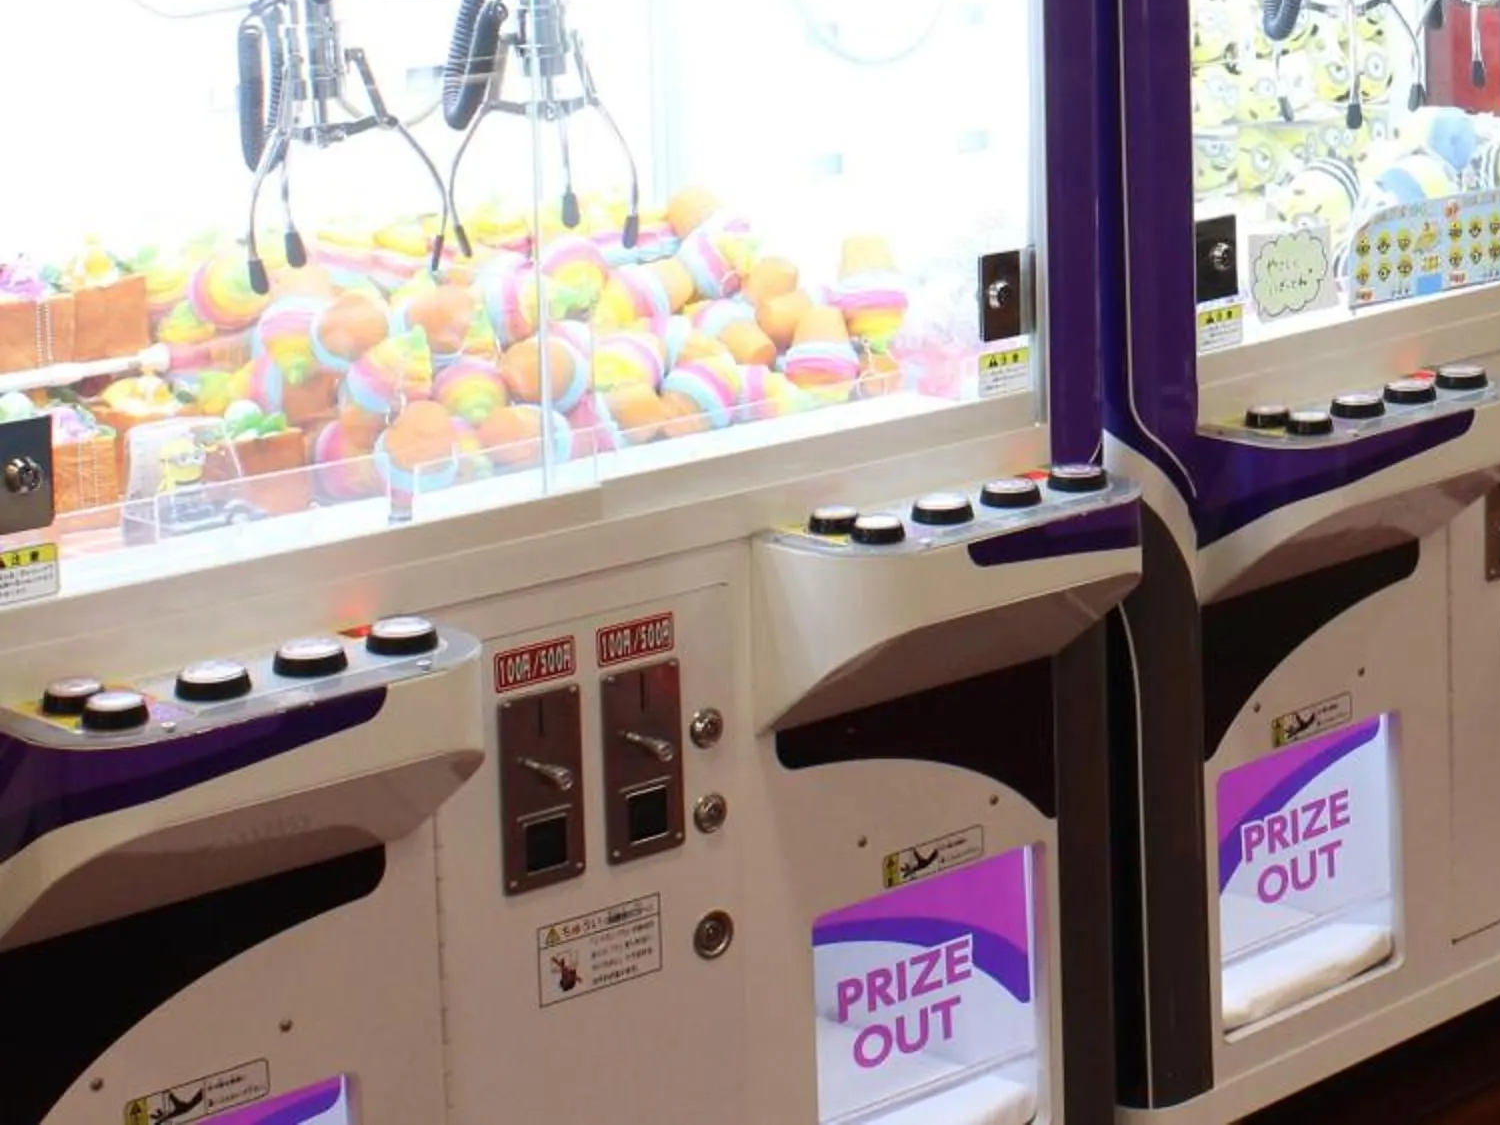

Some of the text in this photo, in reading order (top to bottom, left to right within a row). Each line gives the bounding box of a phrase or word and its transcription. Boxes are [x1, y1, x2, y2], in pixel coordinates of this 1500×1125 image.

[1243, 789, 1350, 864] PRIZE
[1257, 839, 1342, 904] OUT
[837, 938, 972, 1024] PRIZE
[853, 995, 961, 1069] OUT
